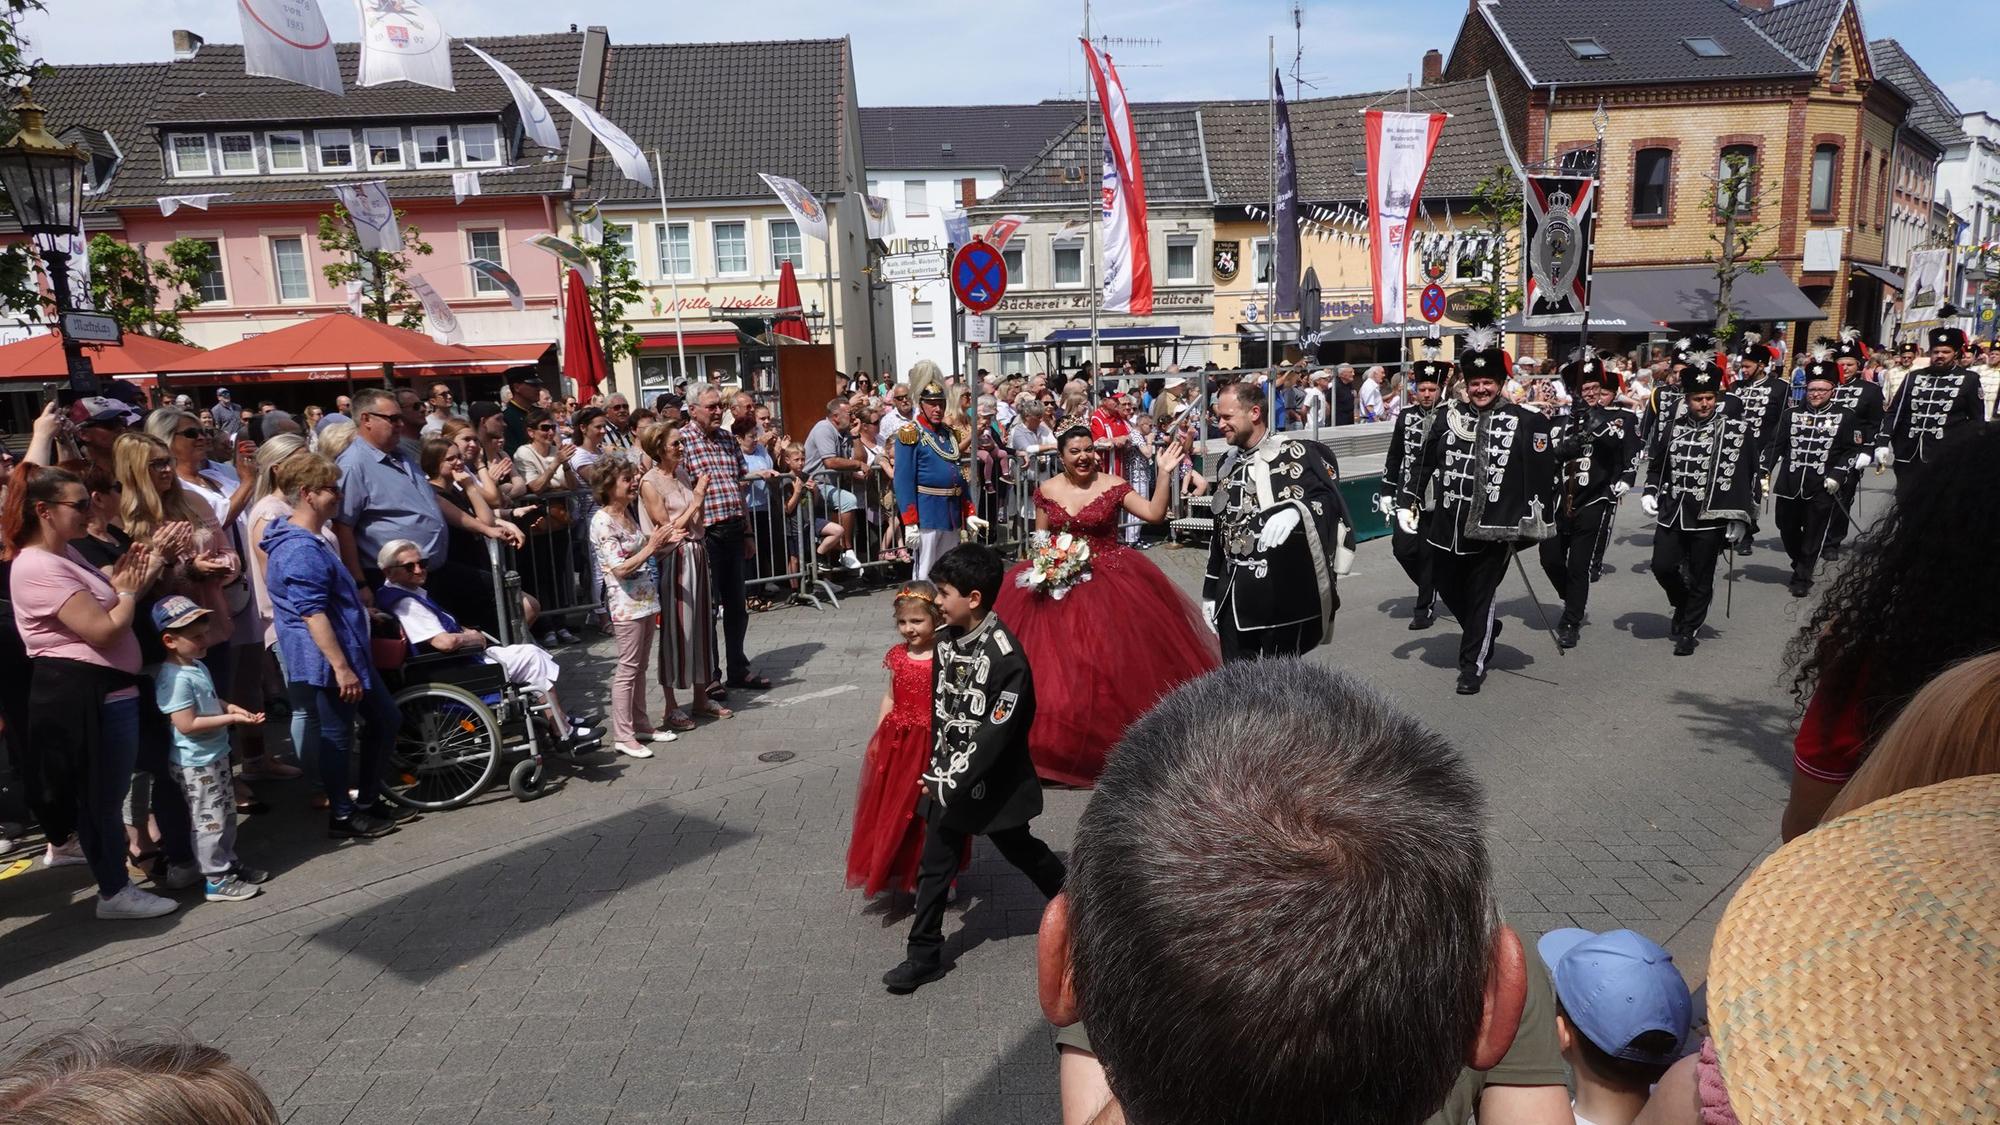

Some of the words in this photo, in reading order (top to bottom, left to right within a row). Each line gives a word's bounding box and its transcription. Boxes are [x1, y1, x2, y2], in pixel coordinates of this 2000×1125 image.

[664, 297, 712, 314] Mille
[999, 297, 1060, 311] Bäckerei
[1152, 292, 1205, 306] nditorei
